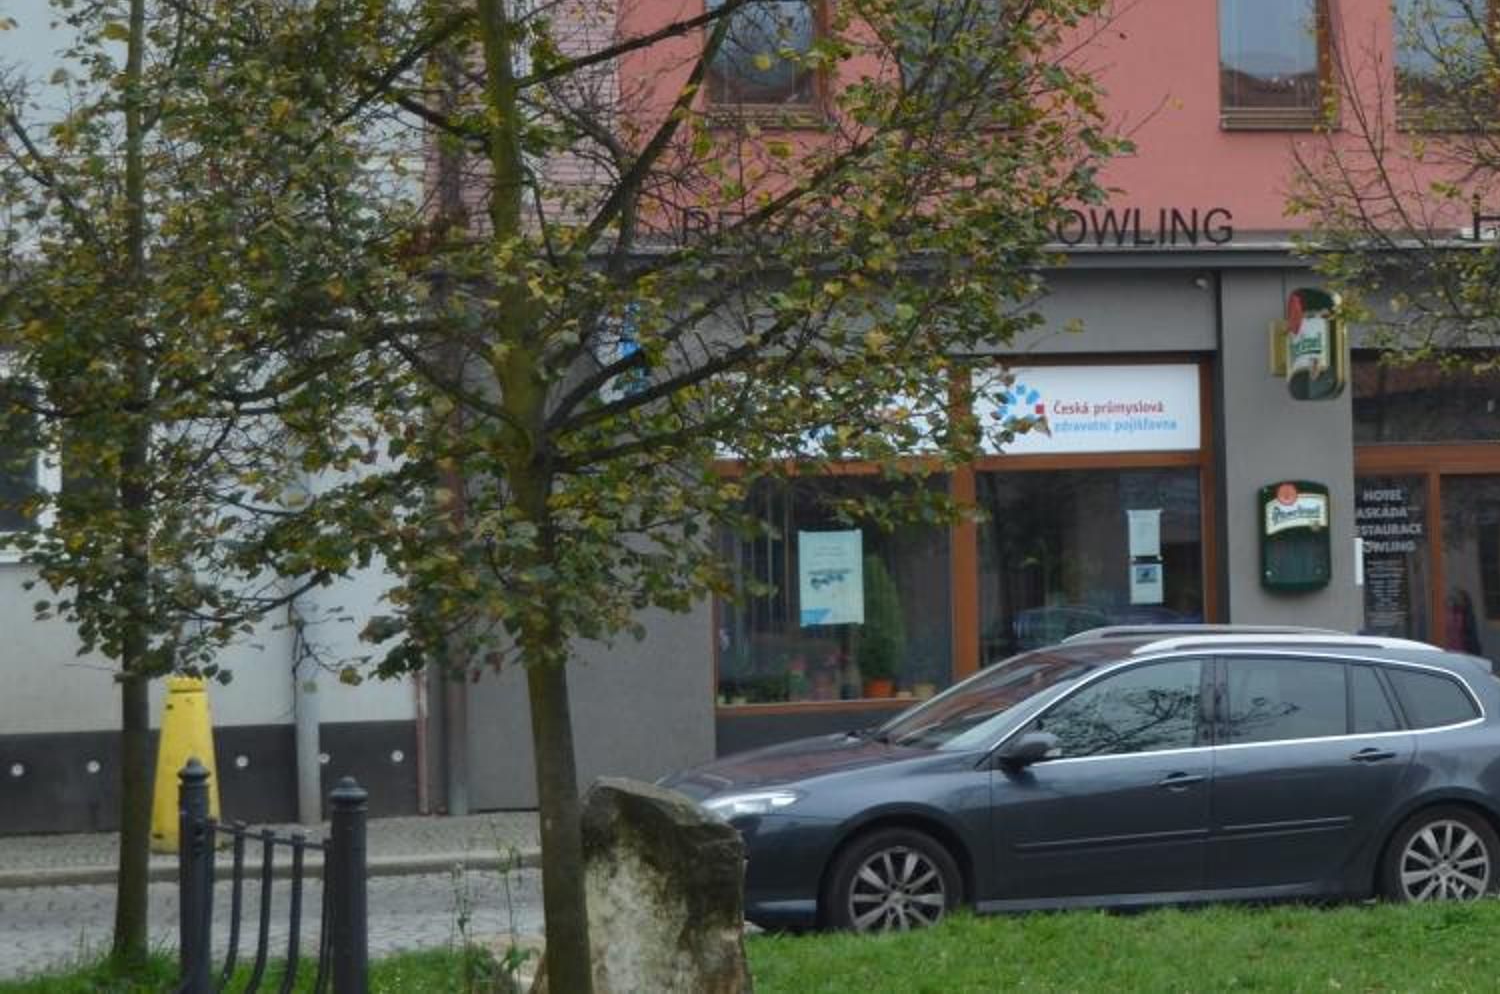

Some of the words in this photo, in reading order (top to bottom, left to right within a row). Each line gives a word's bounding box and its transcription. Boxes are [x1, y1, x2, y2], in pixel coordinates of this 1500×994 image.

[1035, 207, 1233, 246] OWLING
[1363, 489, 1403, 502] HOTEL
[1362, 540, 1416, 553] OWLING
